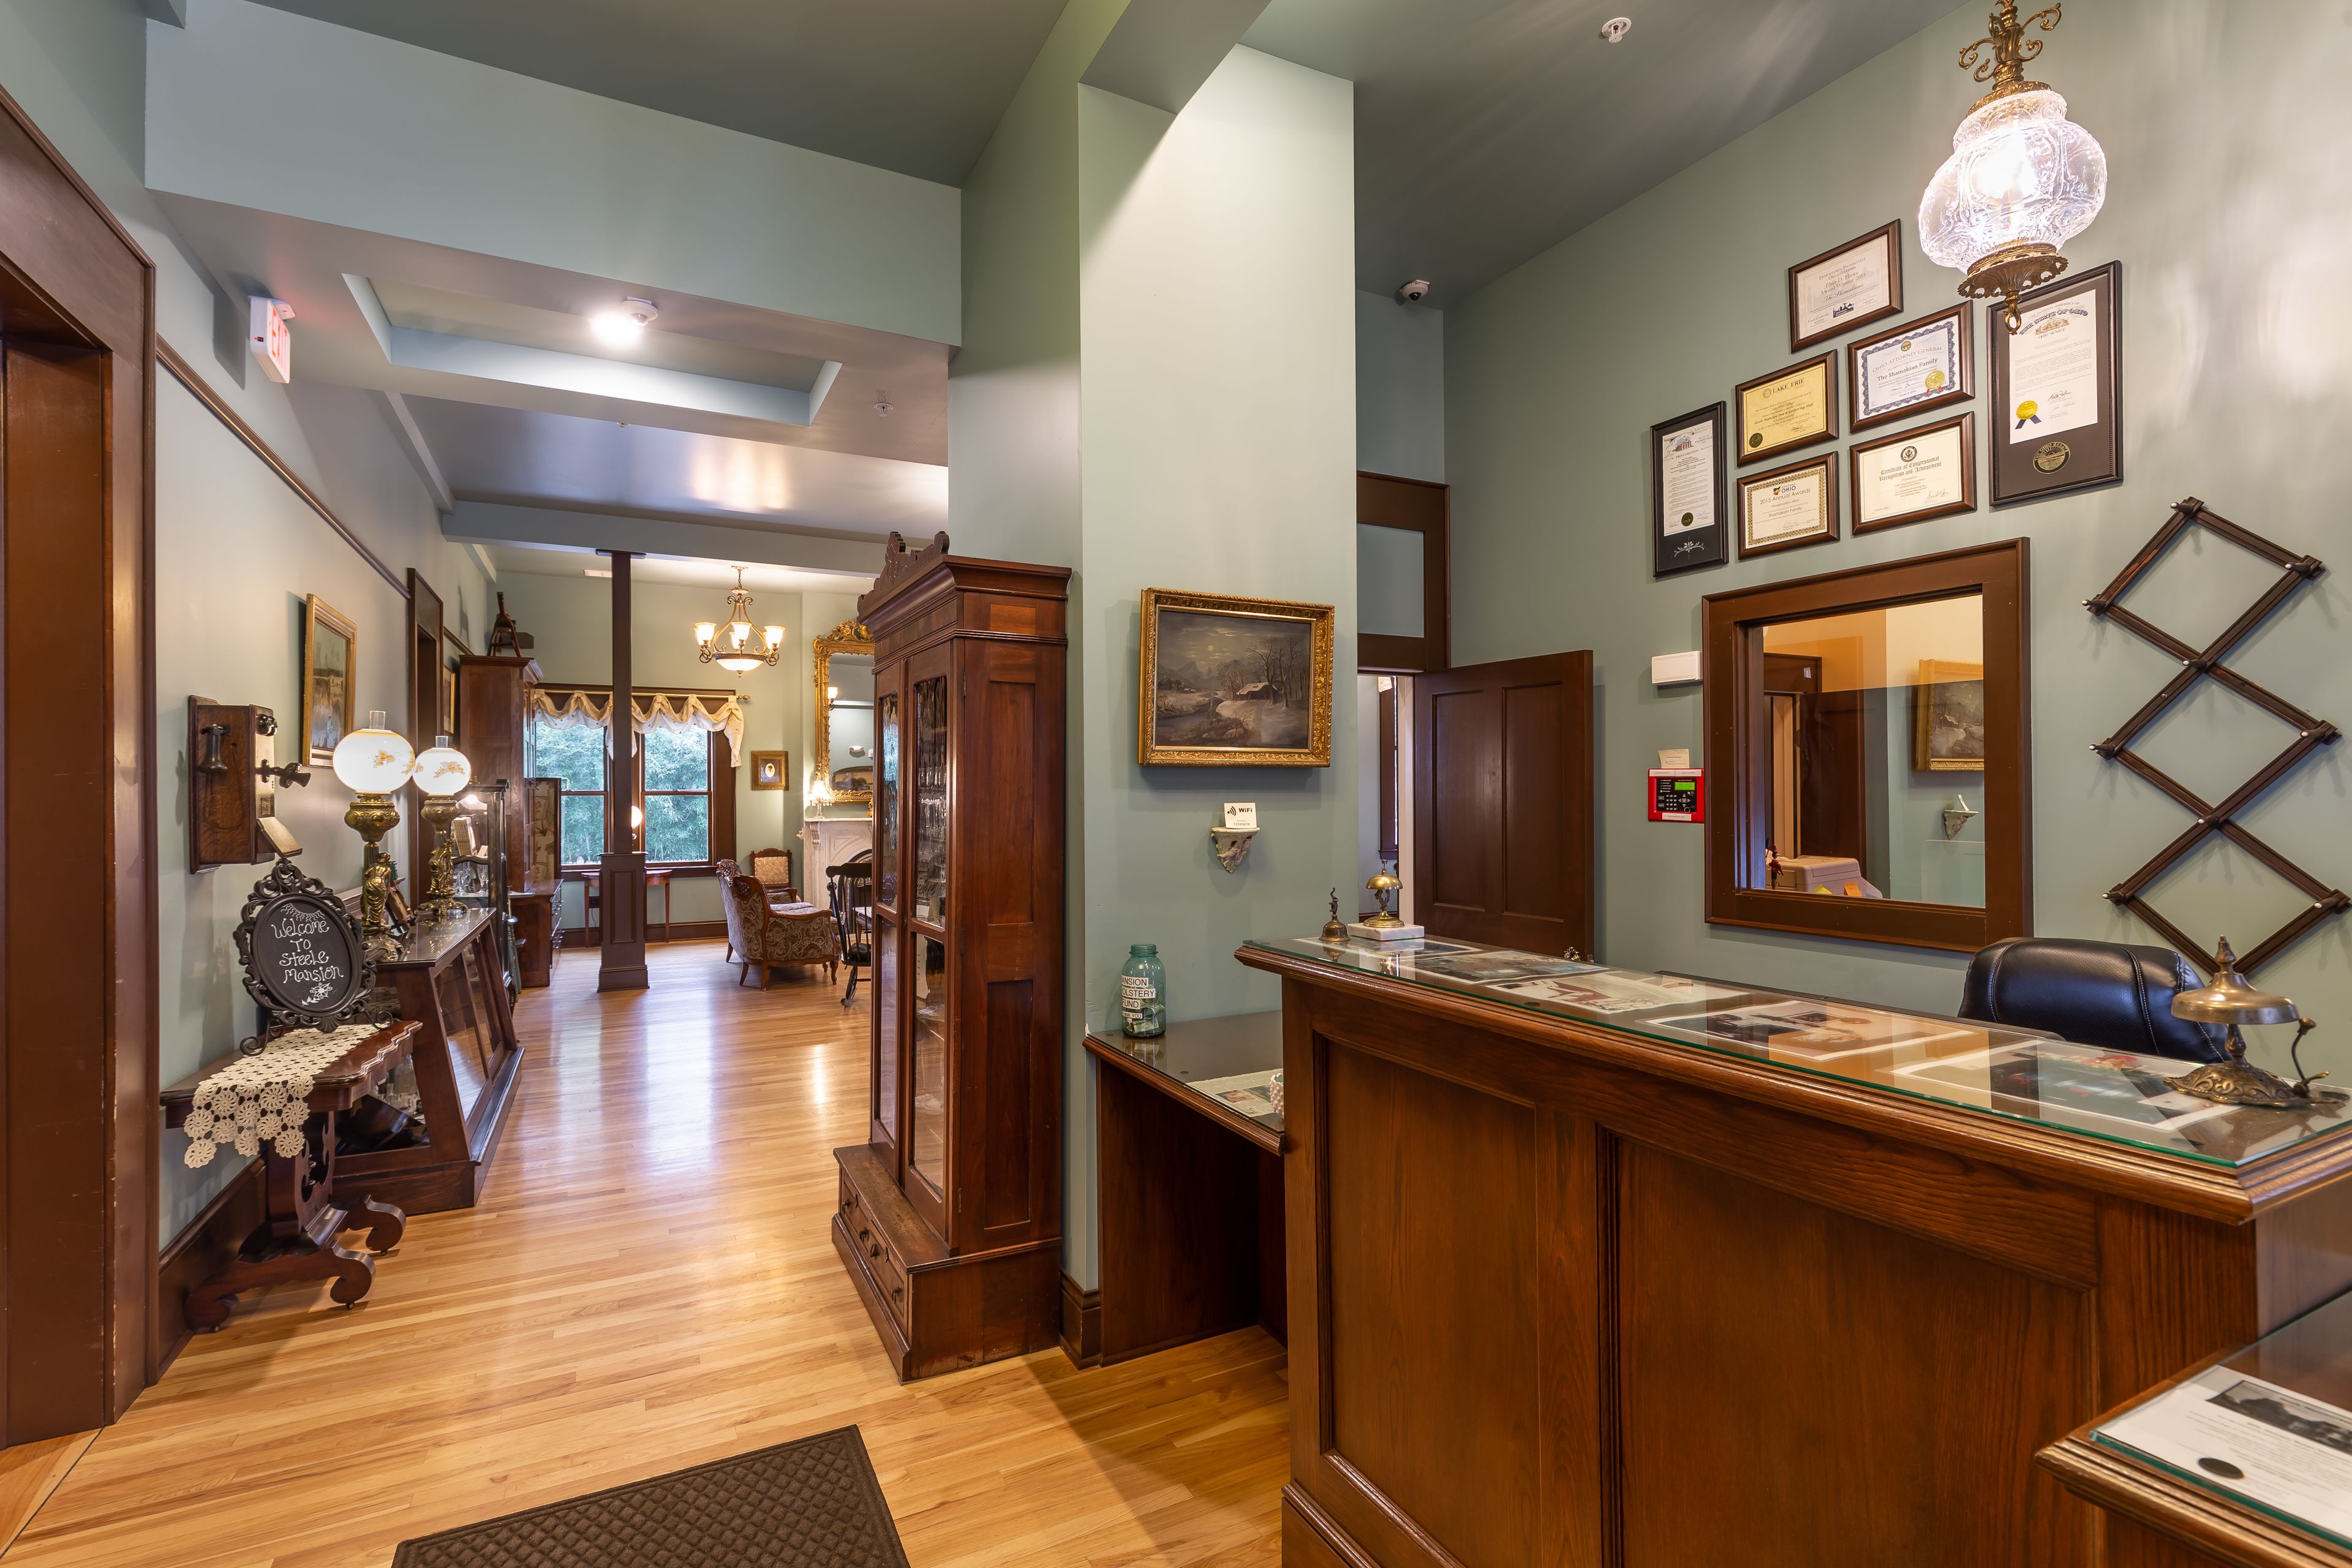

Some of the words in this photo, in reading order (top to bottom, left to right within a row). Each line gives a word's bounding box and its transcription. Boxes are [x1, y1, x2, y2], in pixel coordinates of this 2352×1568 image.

[1845, 271, 1860, 281] Howe
[1820, 285, 1836, 295] Award
[1836, 279, 1854, 288] Winner
[2019, 322, 2034, 336] THE
[1872, 363, 1888, 373] OHIO
[1888, 351, 1917, 364] ATTORNEY
[1918, 346, 1943, 355] GENERAL
[1888, 364, 1918, 378] Shamakian
[1919, 358, 1938, 368] Family
[1773, 384, 1789, 393] LAKE
[1790, 379, 1804, 387] ERIE
[1772, 493, 1790, 502] Annual
[1791, 488, 1811, 497] Awards
[1768, 509, 1790, 518] Shamakian
[1121, 977, 1147, 986] ANSION
[1123, 987, 1155, 997] OLSTERY
